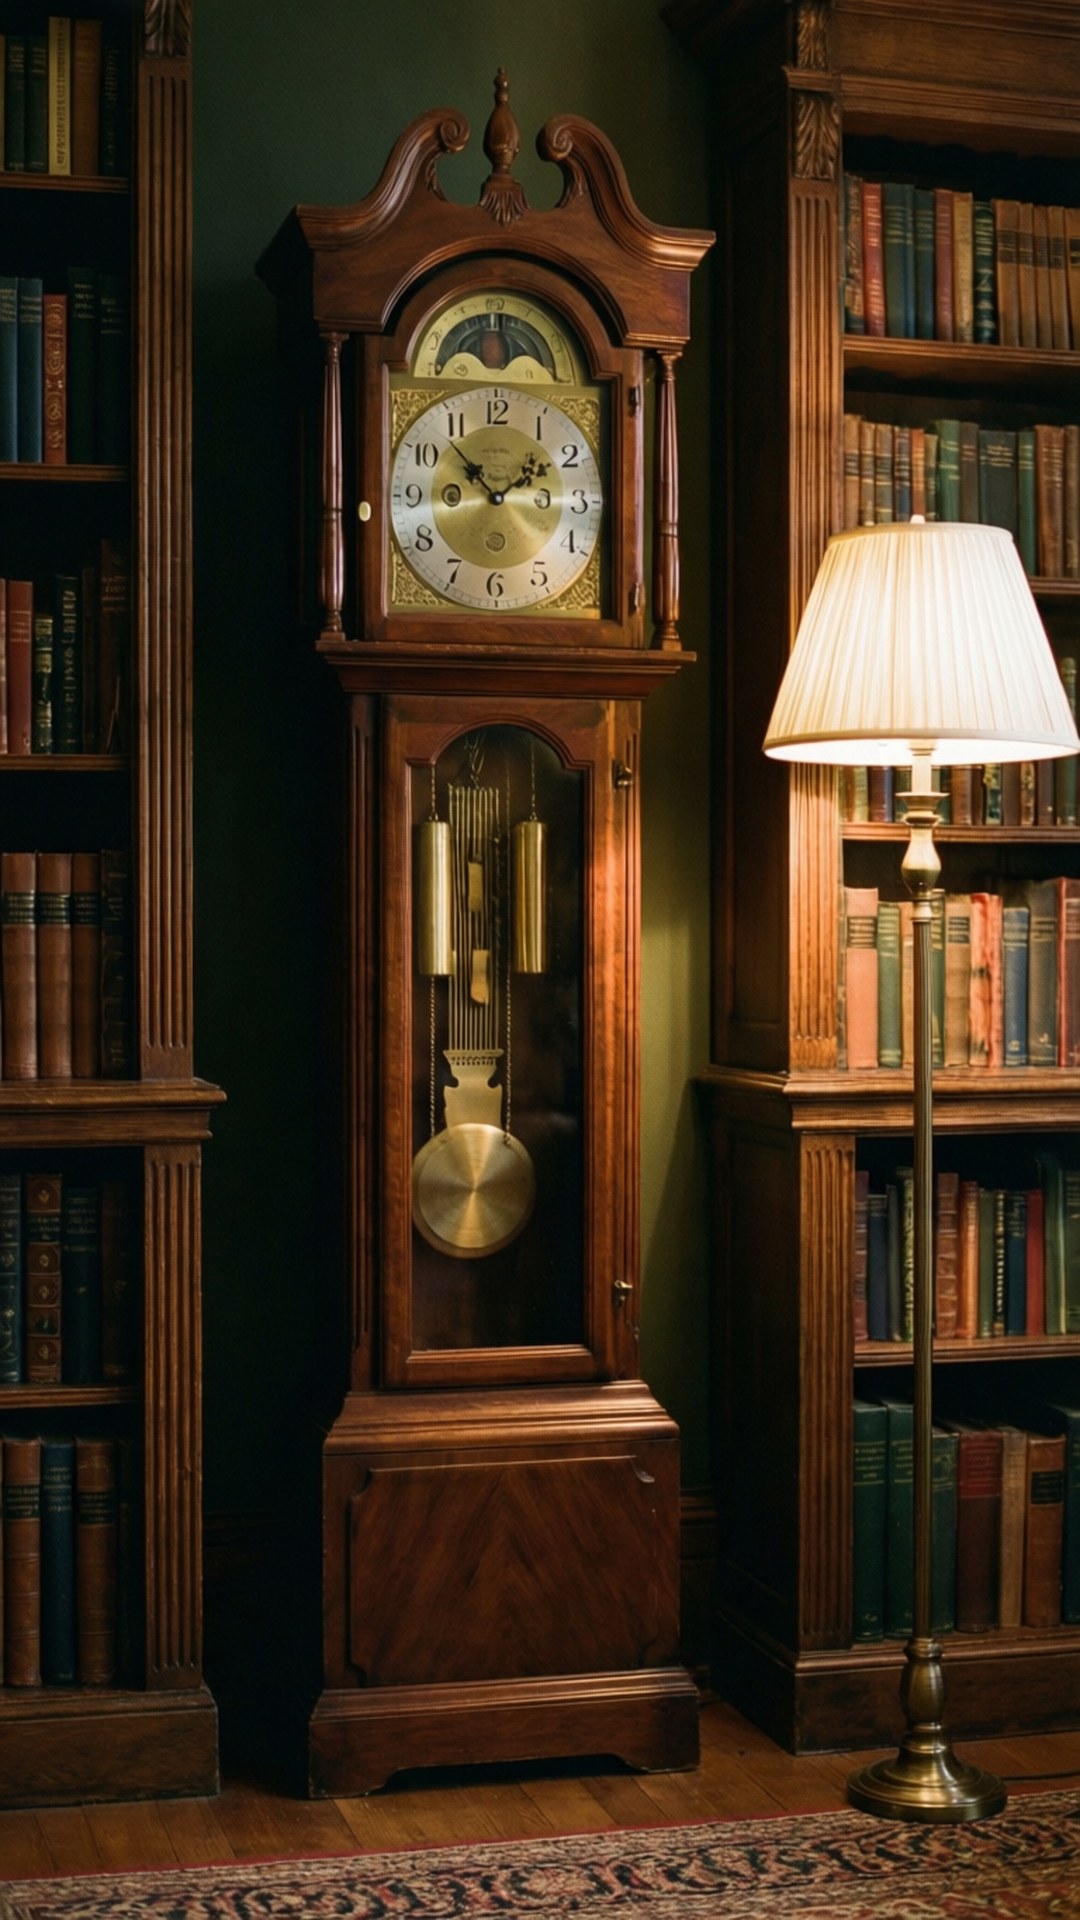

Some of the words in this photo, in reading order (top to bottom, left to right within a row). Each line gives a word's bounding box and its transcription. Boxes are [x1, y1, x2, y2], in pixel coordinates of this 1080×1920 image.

[487, 400, 509, 425] 12
[447, 413, 464, 438] 11
[536, 416, 542, 441] 1
[415, 443, 438, 468] 10
[561, 444, 579, 468] 2
[405, 484, 422, 508] 9
[570, 489, 588, 514] 3
[415, 525, 433, 551] 8
[560, 529, 576, 553] 4
[447, 559, 461, 584] 7
[530, 561, 548, 586] 5
[486, 572, 504, 598] 6
